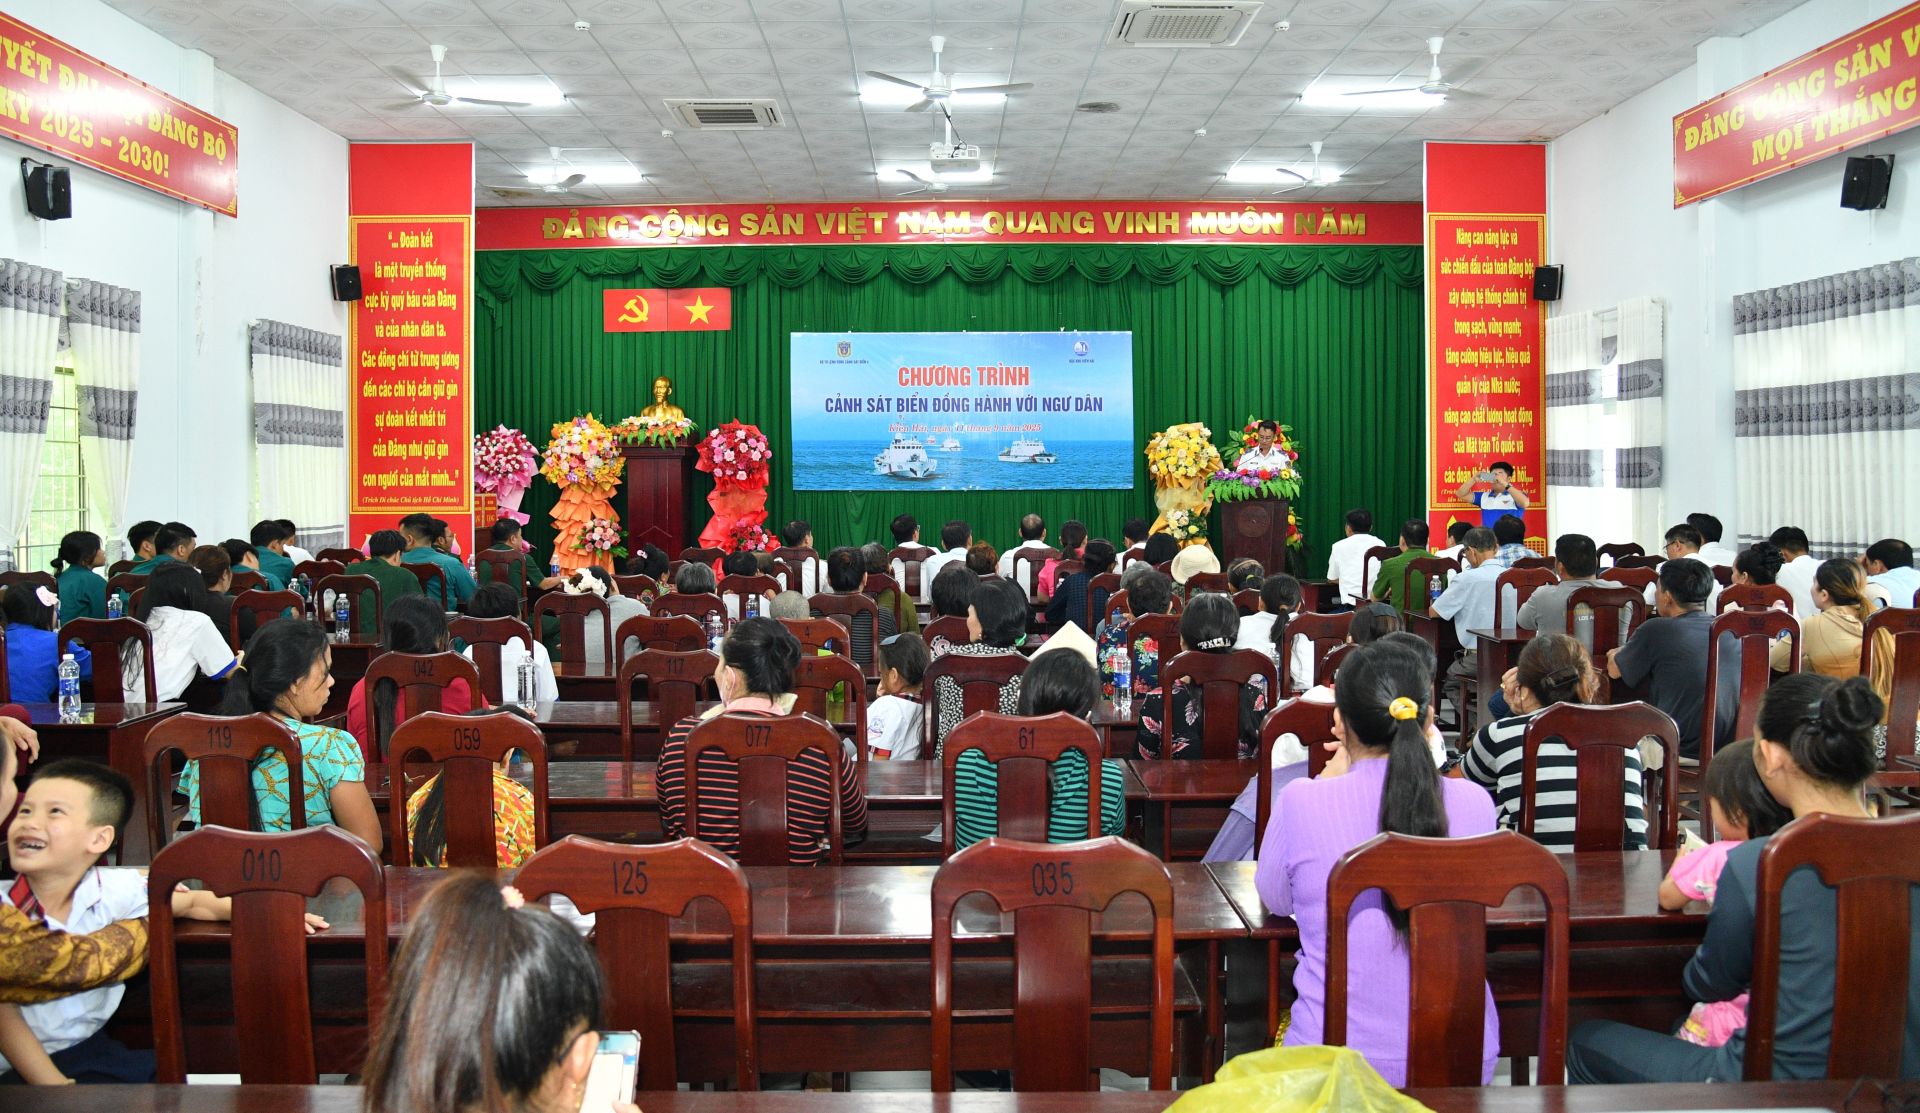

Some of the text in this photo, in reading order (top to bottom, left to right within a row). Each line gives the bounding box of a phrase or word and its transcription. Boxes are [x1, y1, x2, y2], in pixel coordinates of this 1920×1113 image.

[0, 34, 52, 85] YẾT
[148, 107, 199, 149] ĐẢNG
[203, 130, 227, 166] BỘ
[1684, 37, 1892, 152] ĐẢNG CỘNG SẢN
[1752, 77, 1917, 165] MỌI THẮNG
[118, 135, 169, 178] 2030!
[542, 205, 1366, 245] ĐẢNG CỘNG SẢN VIỆT NAM QUANG VINH MUÔN NĂM
[400, 228, 433, 248] Đoàn kết
[1456, 228, 1518, 250] Nâng cao năng lực và
[375, 261, 382, 278] là
[384, 262, 398, 283] một
[425, 257, 446, 280] thống
[1441, 257, 1452, 274] sức
[1453, 254, 1469, 274] chiến
[1470, 254, 1481, 274] đấu
[1482, 256, 1494, 274] của
[1494, 257, 1508, 274] toàn
[1508, 256, 1524, 278] Đảng
[365, 288, 457, 313] cực kỳ quý báu của Đảng
[1449, 284, 1527, 309] xây dựng hệ thống chính trị
[375, 320, 384, 338] và
[385, 318, 400, 337] của
[401, 320, 420, 337] nhân
[421, 320, 435, 337] dân
[1454, 318, 1470, 337] trong
[1488, 317, 1502, 337] vững
[361, 347, 460, 370] Các đồng chí từ trung ương
[1445, 347, 1460, 368] tăng
[1460, 347, 1478, 368] cường
[1479, 347, 1492, 368] hiệu
[1505, 347, 1518, 368] hiệu
[1519, 345, 1531, 368] quả
[898, 362, 1030, 386] CHƯƠNG TRÌNH
[1456, 375, 1471, 397] quản
[1471, 377, 1478, 397] lý
[1479, 375, 1490, 394] của
[1491, 376, 1503, 394] Nhà
[363, 377, 377, 398] đến
[378, 379, 393, 398] các
[406, 379, 417, 402] bộ
[417, 376, 432, 397] cần
[433, 378, 446, 400] giữ
[446, 379, 458, 400] gìn
[825, 391, 1103, 413] CẢNH SÁT BIỂN ĐỒNG HÀNH VỚI NGƯ DÂN
[375, 406, 446, 432] sự đoàn kết nhất trí
[1444, 403, 1533, 428] nâng cao chất lượng hoạt động
[372, 438, 449, 460] của Đảng như giữ gìn
[1453, 432, 1524, 458] của Mặt trận Tổ quốc và
[362, 473, 377, 487] con
[378, 469, 399, 490] người
[400, 468, 414, 487] của
[415, 466, 430, 487] mắt
[1444, 466, 1455, 483] các
[413, 660, 433, 677] 042
[208, 725, 232, 749] 119
[454, 728, 481, 751] 059
[745, 724, 771, 748] 077
[1019, 726, 1035, 751] 61
[242, 848, 282, 882] 010
[613, 860, 649, 895] 125
[1032, 861, 1073, 896] 035
